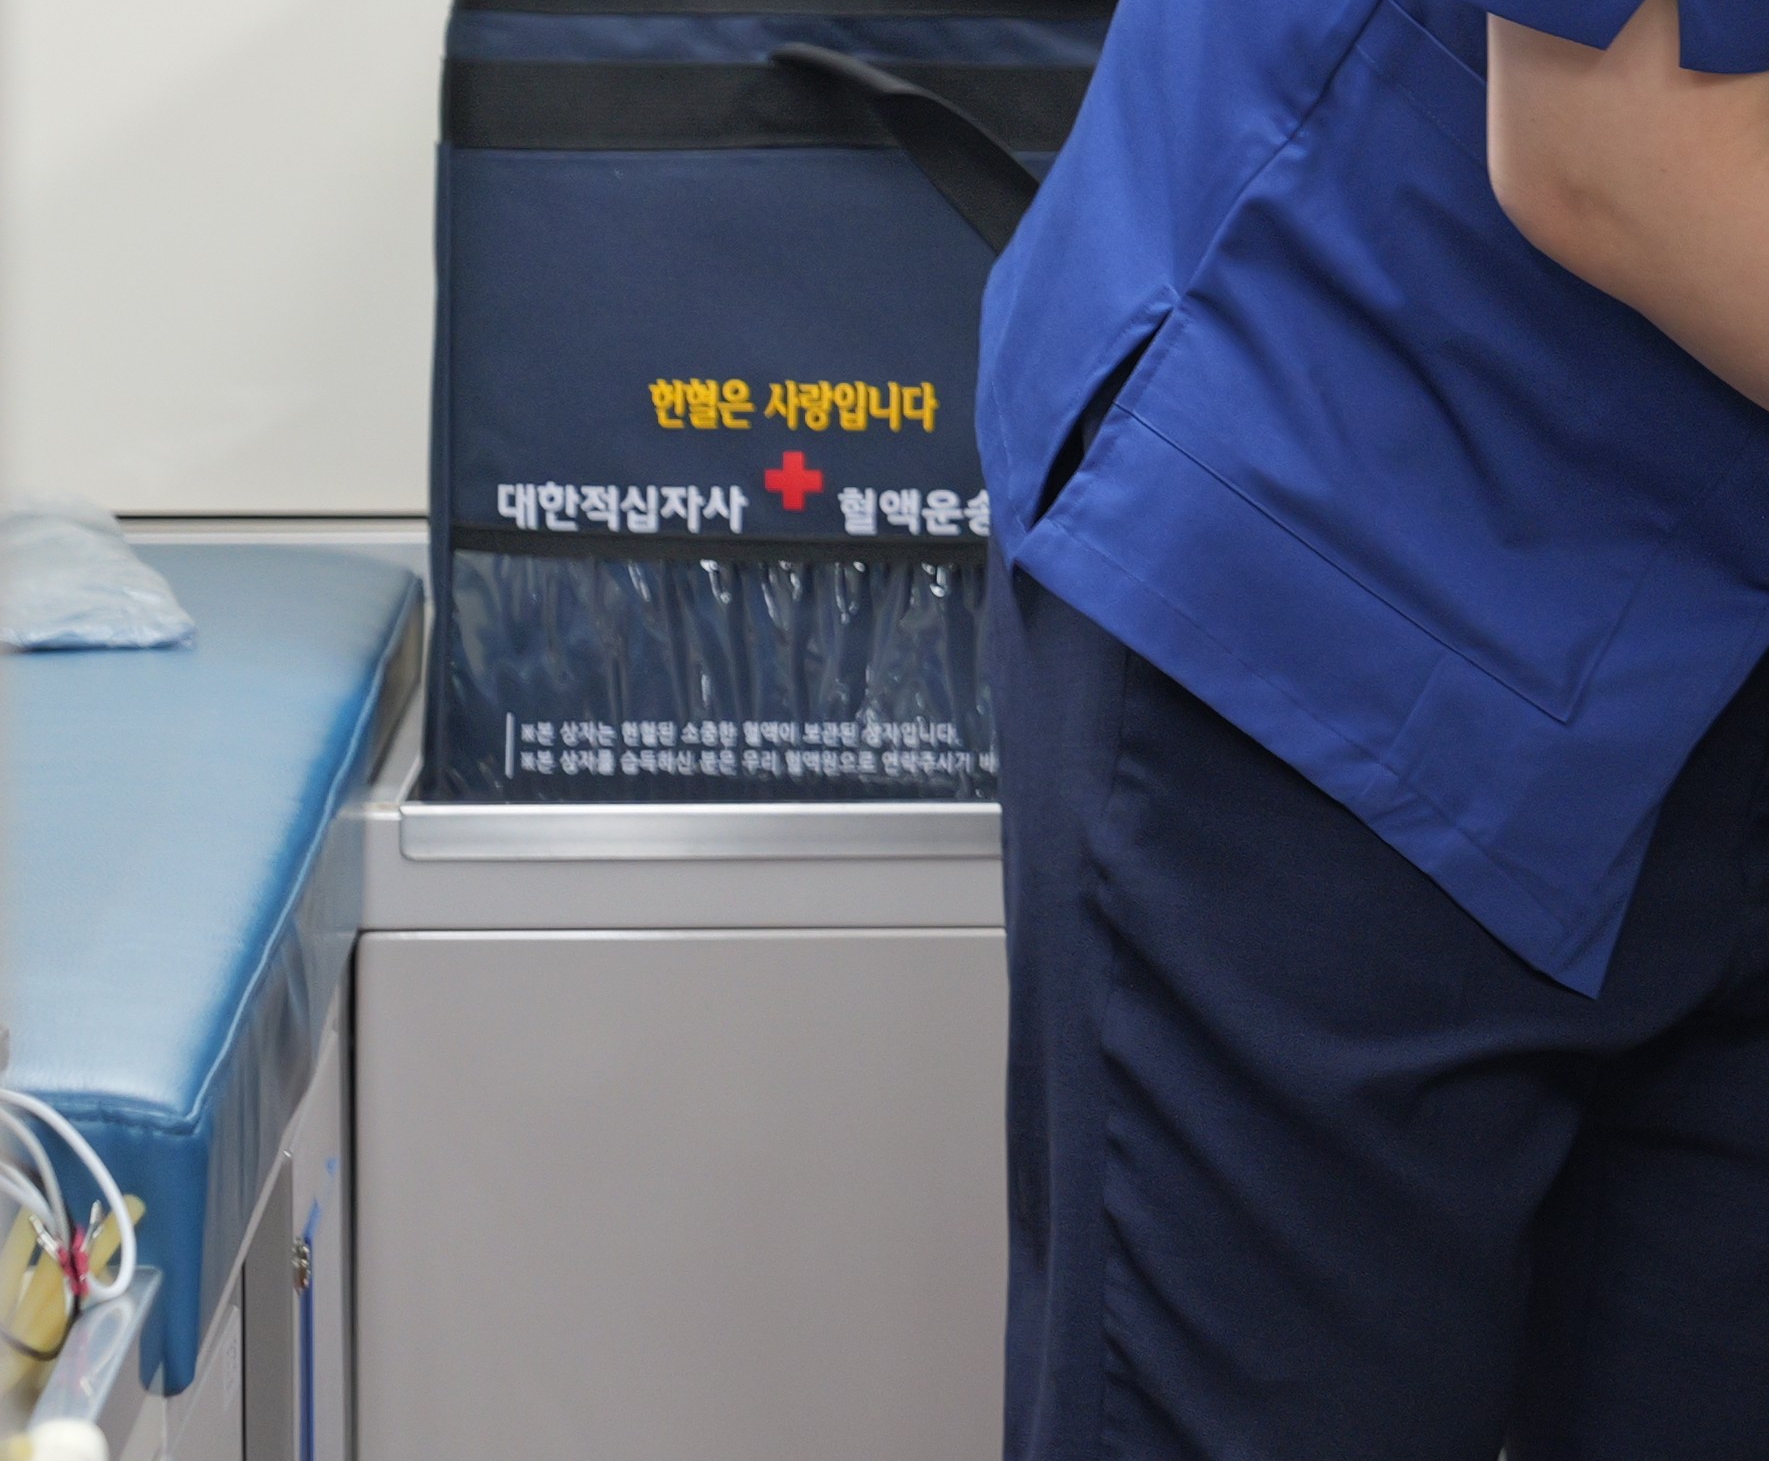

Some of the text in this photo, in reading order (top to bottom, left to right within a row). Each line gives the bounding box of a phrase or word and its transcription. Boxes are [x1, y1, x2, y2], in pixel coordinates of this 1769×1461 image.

[648, 378, 940, 433] 헌혈은 사랑입니다
[497, 482, 749, 534] 대한적십자사
